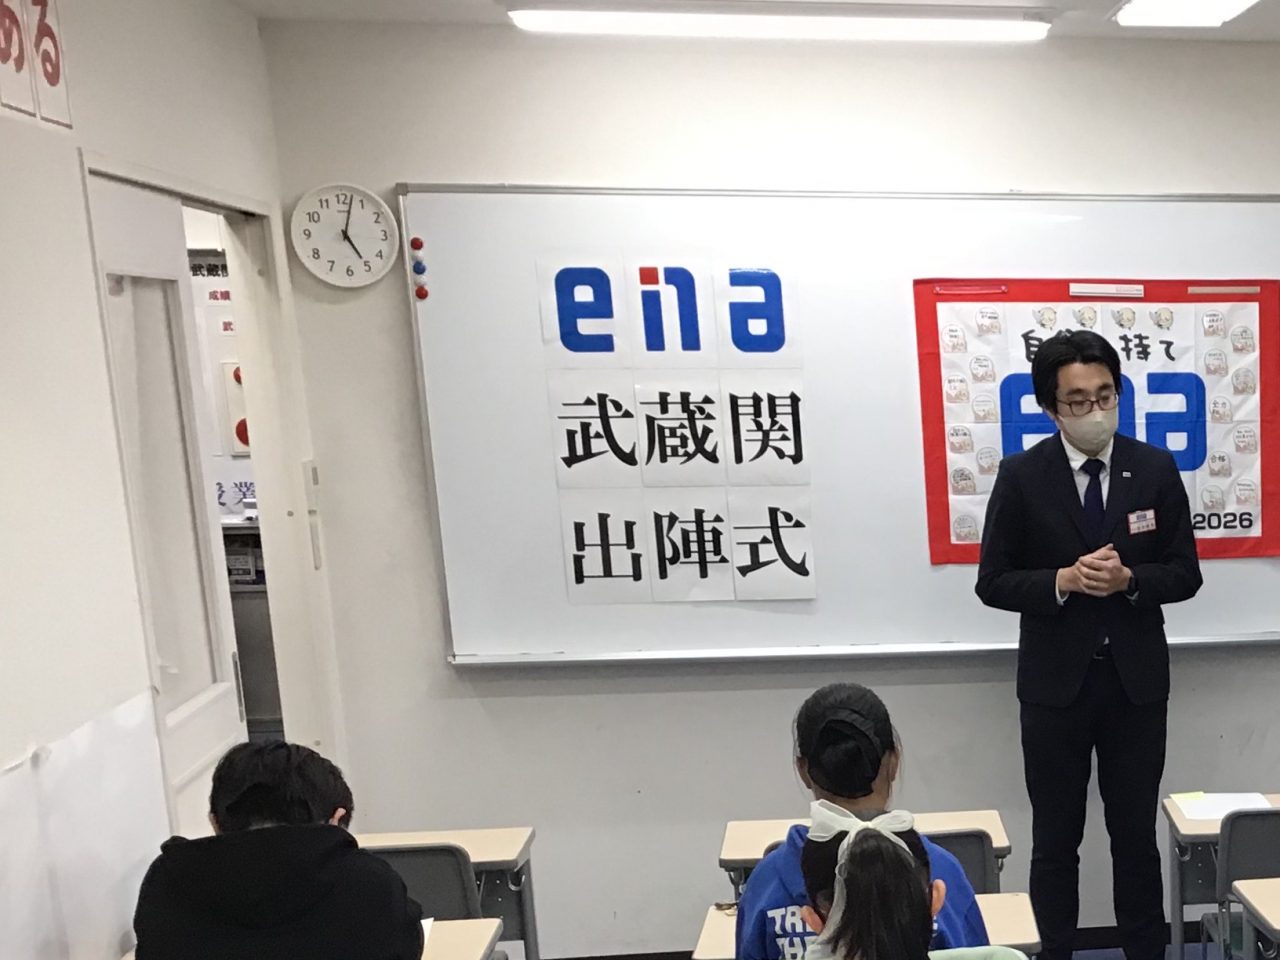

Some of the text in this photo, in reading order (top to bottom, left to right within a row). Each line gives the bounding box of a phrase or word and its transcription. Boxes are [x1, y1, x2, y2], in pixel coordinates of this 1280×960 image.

[318, 198, 330, 209] 11
[335, 193, 349, 205] 12
[359, 199, 364, 209] 1
[306, 211, 321, 223] 10
[373, 212, 382, 223] 2
[303, 229, 312, 240] 9
[380, 230, 388, 241] 3
[312, 248, 321, 260] 8
[375, 249, 384, 260] 4
[327, 260, 335, 272] 7
[346, 265, 354, 277] 6
[363, 261, 372, 272] 5
[555, 267, 786, 353] ena
[557, 391, 805, 468] 武蔵関
[1193, 512, 1254, 530] 2026
[573, 506, 811, 584] 出陣式
